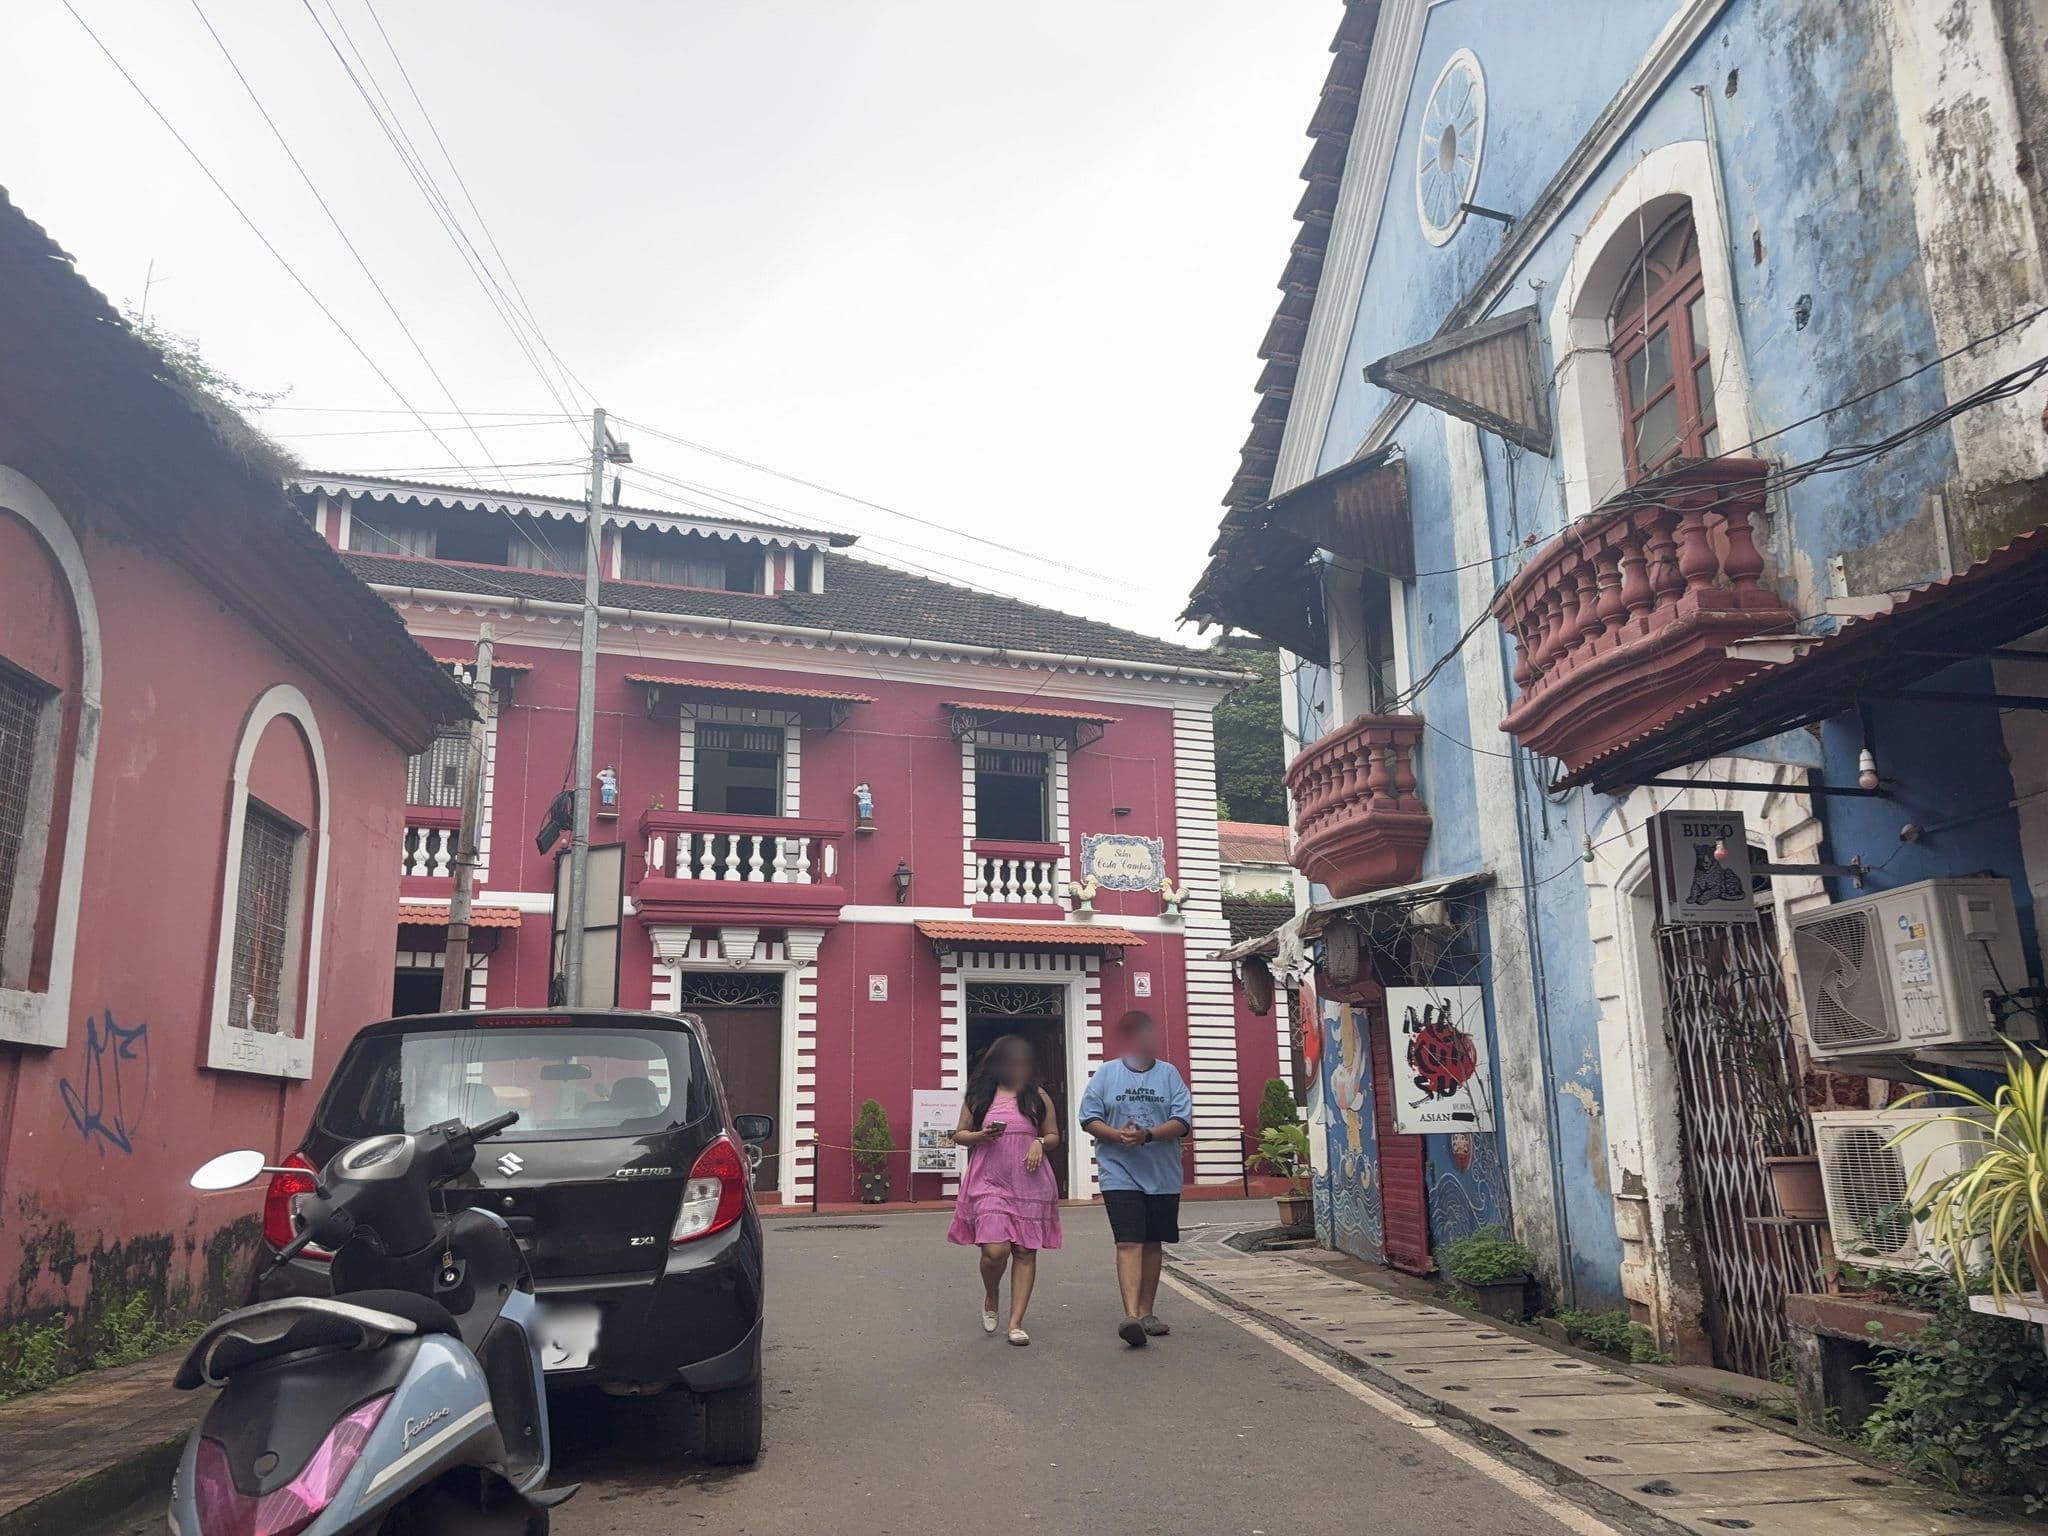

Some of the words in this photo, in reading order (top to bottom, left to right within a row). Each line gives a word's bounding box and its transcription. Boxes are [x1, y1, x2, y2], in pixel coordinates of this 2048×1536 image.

[1129, 1095, 1165, 1104] NOTHING
[1419, 1113, 1451, 1122] ASIAN
[615, 1166, 672, 1177] CELERIO
